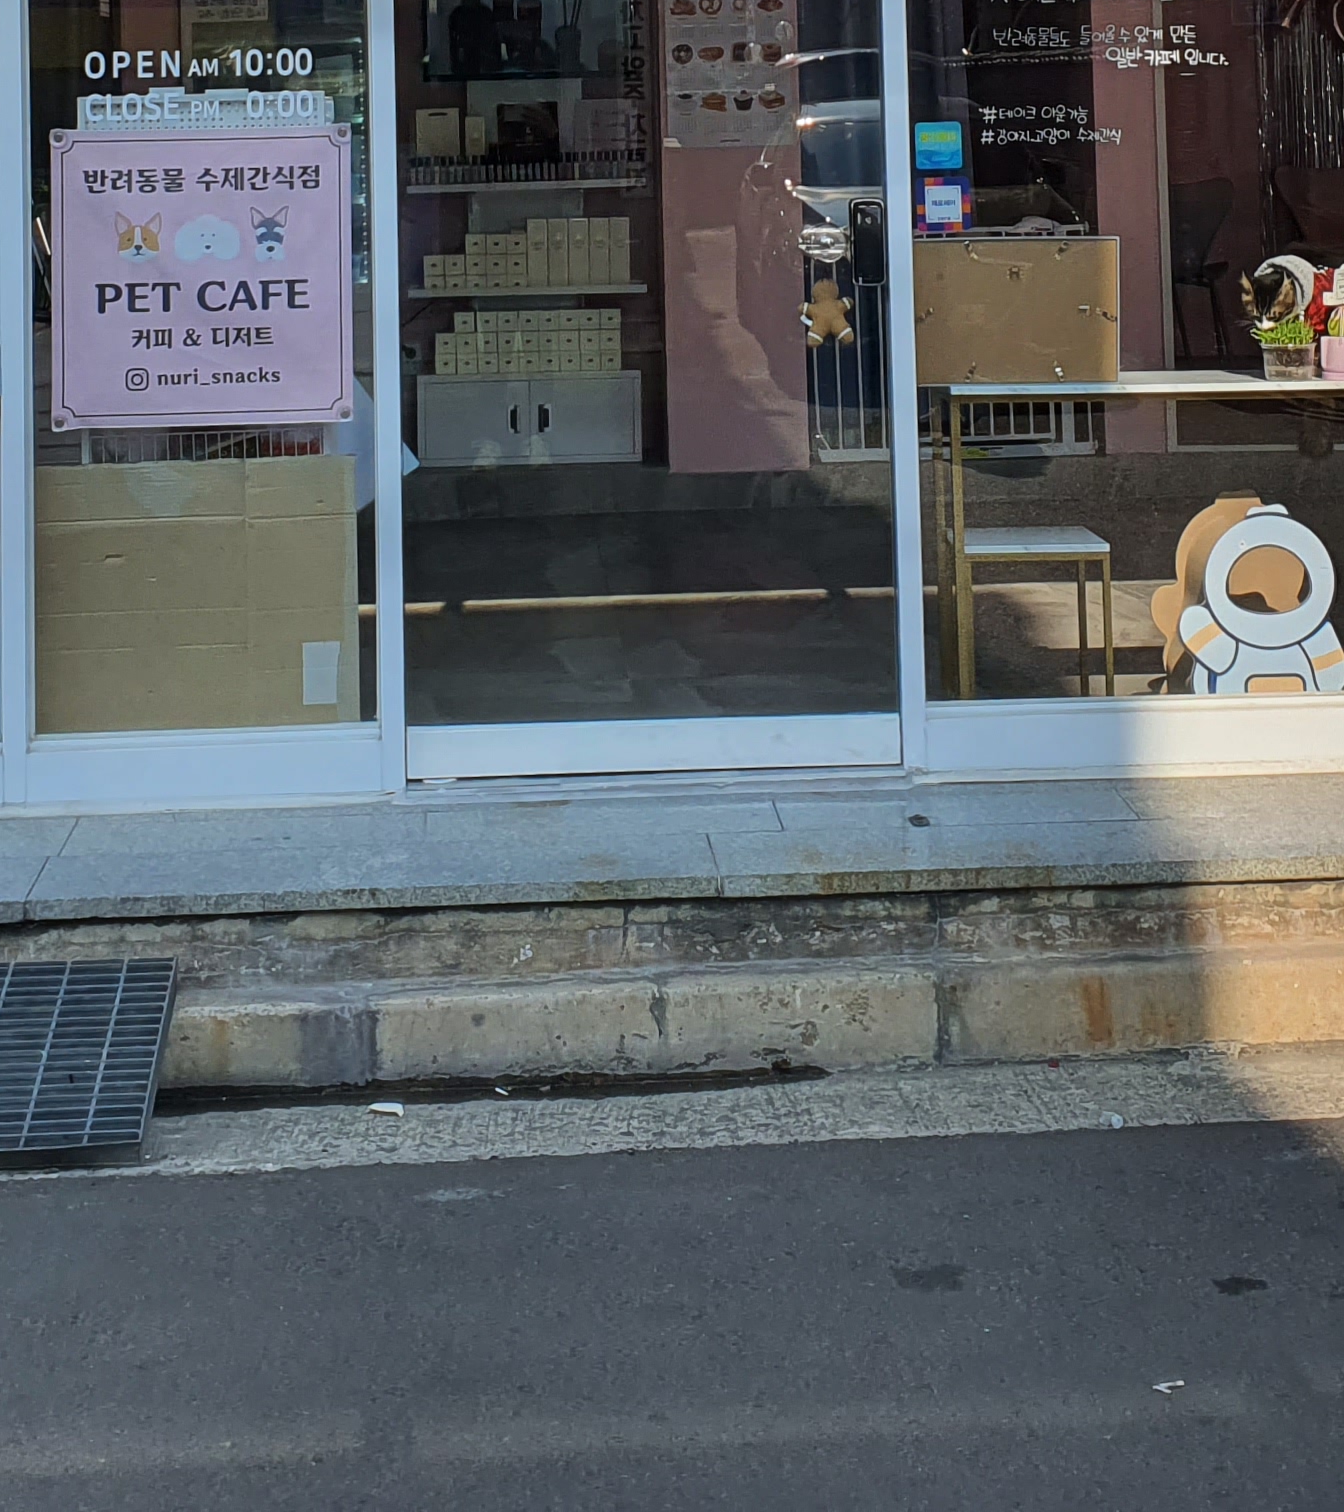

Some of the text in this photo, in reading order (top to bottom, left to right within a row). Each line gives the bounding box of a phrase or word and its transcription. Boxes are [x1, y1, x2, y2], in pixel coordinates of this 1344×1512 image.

[992, 26, 1070, 47] 반려동물들도
[1169, 25, 1197, 44] 만든
[84, 48, 313, 79] OPEN AM 10:00
[85, 93, 180, 121] CLOSE
[190, 100, 220, 119] PM
[82, 165, 321, 194] 반려동물 수제간식점
[94, 279, 310, 315] PET CAFE
[131, 327, 275, 350] 커피 & 디저트
[156, 367, 281, 387] nuri_snacks
